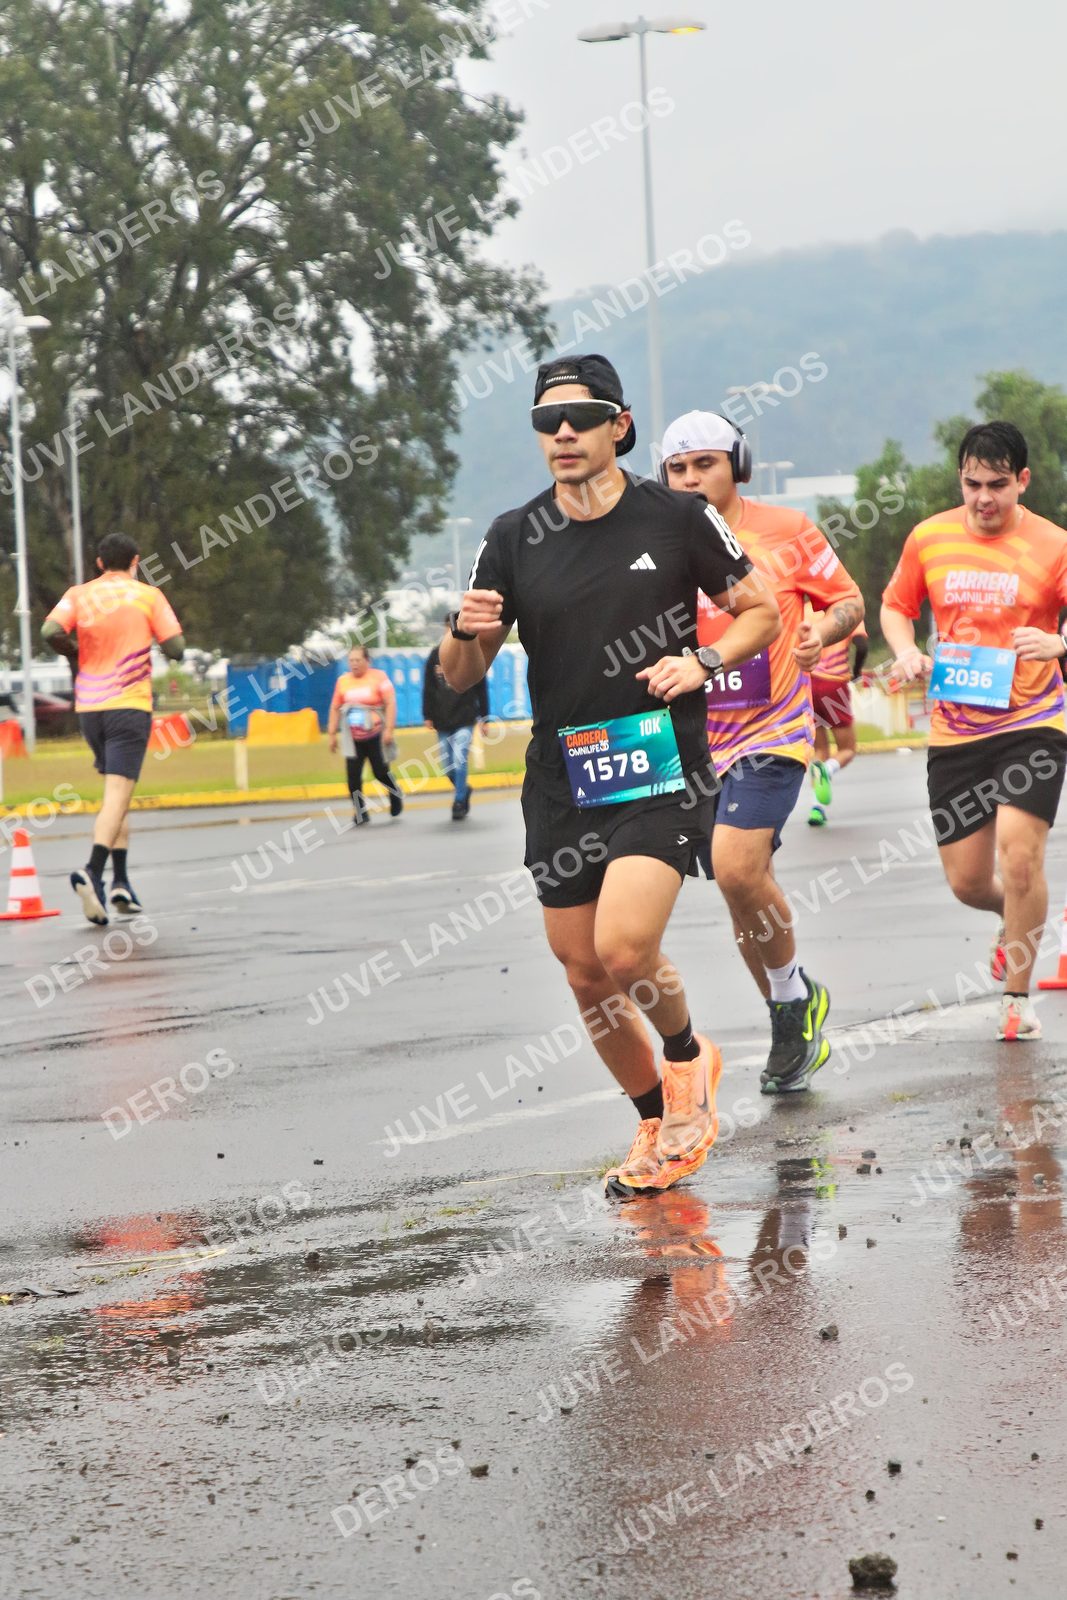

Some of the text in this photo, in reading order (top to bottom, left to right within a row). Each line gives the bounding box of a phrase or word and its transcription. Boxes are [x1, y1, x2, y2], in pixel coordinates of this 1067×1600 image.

[945, 570, 1019, 596] CARRERA
[944, 667, 993, 688] 2036
[639, 716, 662, 736] 10K
[566, 728, 609, 748] CARRERA
[583, 750, 650, 783] 1578
